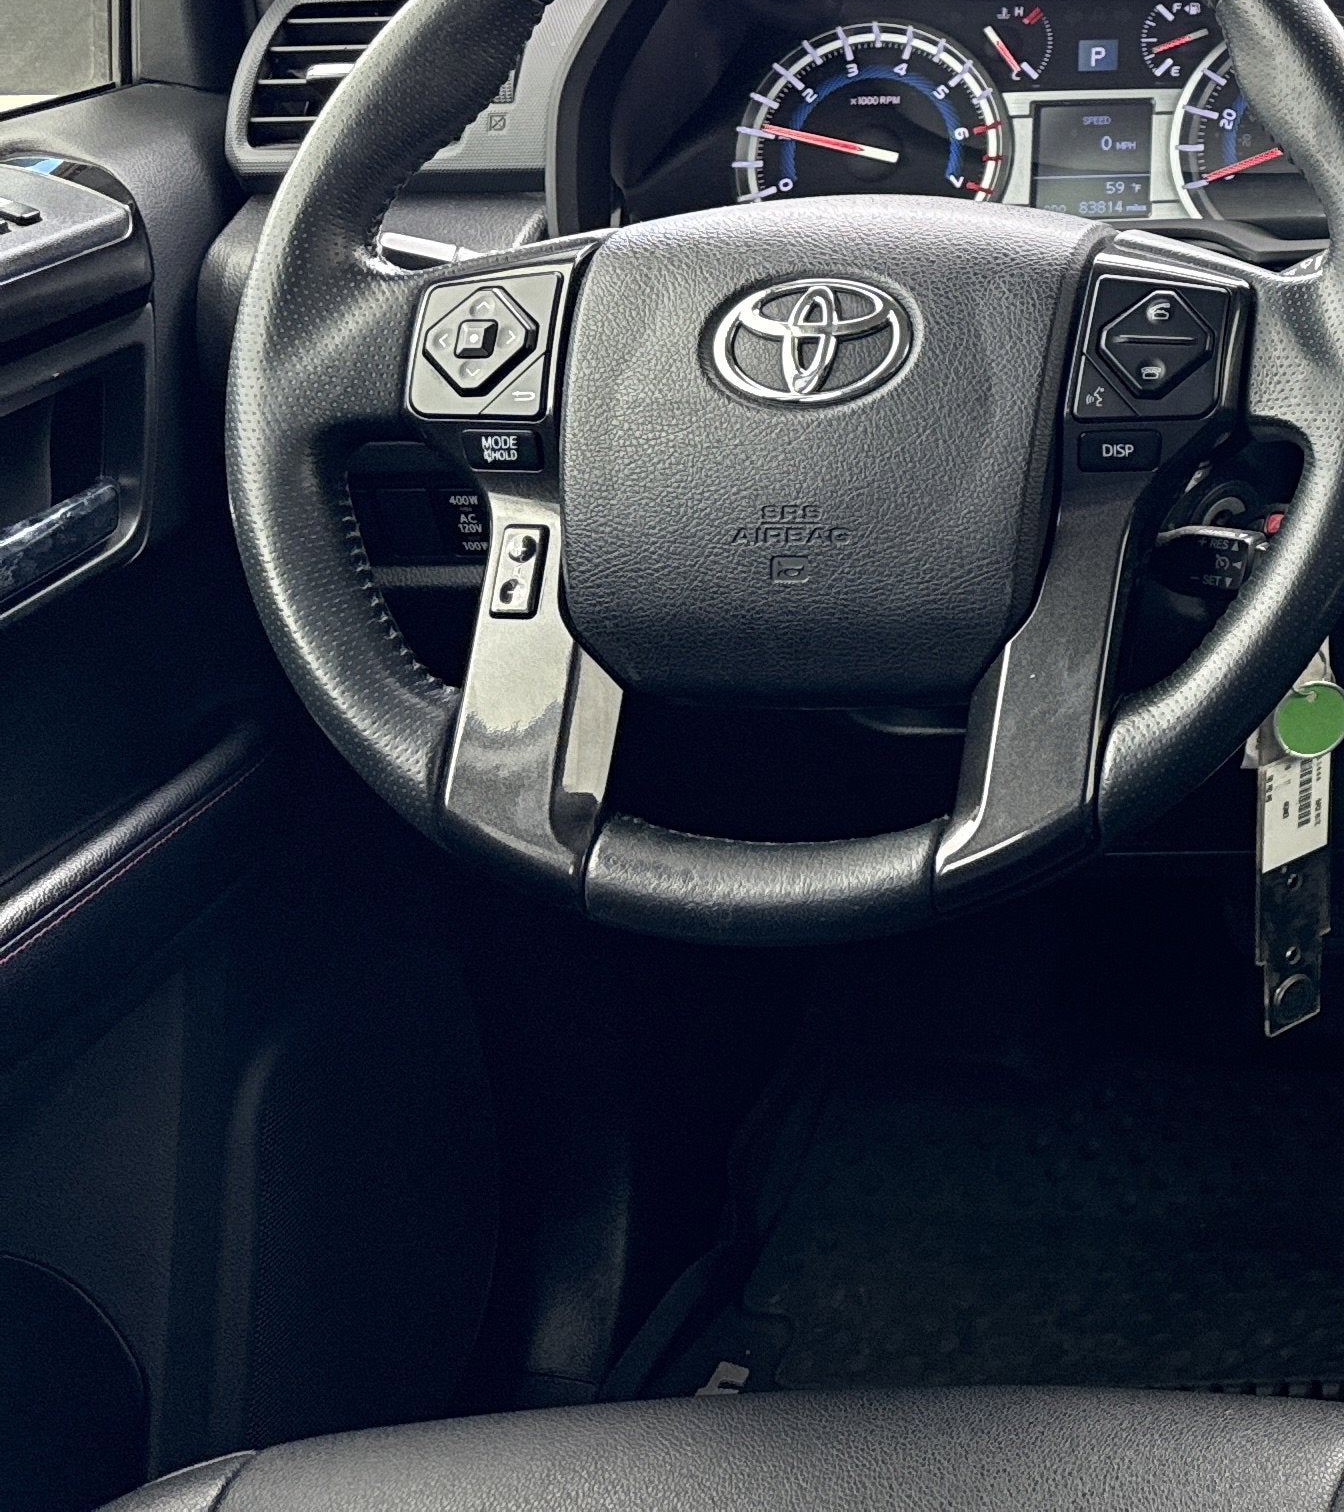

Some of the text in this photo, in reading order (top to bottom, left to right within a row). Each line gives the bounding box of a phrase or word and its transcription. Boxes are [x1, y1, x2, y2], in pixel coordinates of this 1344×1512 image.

[1014, 6, 1024, 17] H
[1172, 3, 1182, 13] F
[1090, 46, 1106, 67] P
[846, 63, 859, 77] 3
[893, 63, 907, 76] 4
[1170, 65, 1181, 77] E
[803, 88, 818, 103] 2
[933, 84, 949, 100] 5
[880, 95, 901, 105] RPM
[1082, 115, 1112, 125] SPEED
[1219, 109, 1237, 130] 20
[954, 126, 969, 141] 6
[1101, 136, 1137, 151] 0 MPH
[778, 178, 794, 192] 0
[949, 175, 964, 189] 7
[1105, 181, 1125, 194] 59
[1078, 201, 1123, 214] 83814
[481, 435, 518, 449] MODE
[492, 449, 518, 461] HOLD
[1102, 444, 1134, 457] DISP
[449, 495, 478, 505] 400W
[460, 513, 477, 524] AC
[458, 523, 482, 533] 120V
[731, 526, 850, 544] AIRBAG
[1210, 539, 1229, 550] RES
[1202, 575, 1222, 587] SET
